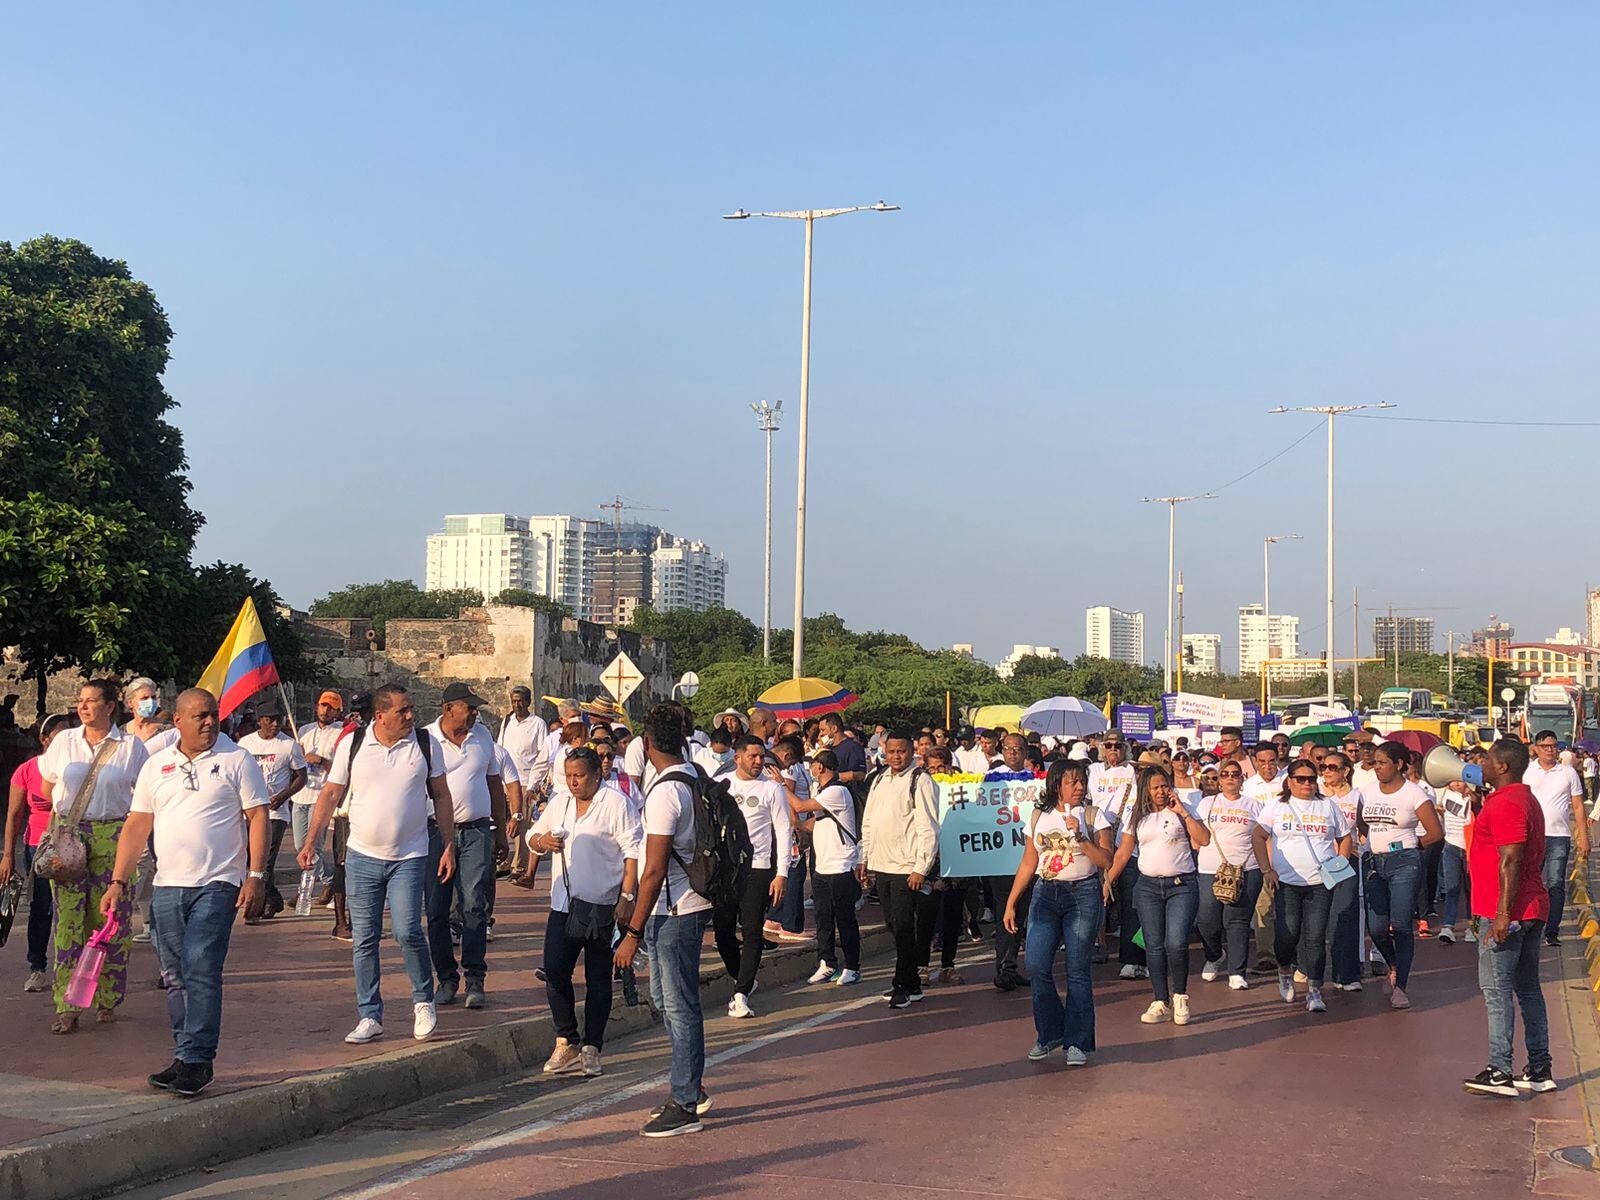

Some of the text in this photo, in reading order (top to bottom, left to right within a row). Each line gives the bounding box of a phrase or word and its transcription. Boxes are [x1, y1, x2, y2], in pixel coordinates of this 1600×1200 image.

[1220, 815, 1249, 826] SIRVE
[1302, 814, 1326, 823] EPS
[1295, 823, 1328, 834] SIRVE
[959, 827, 1026, 853] PERO N
